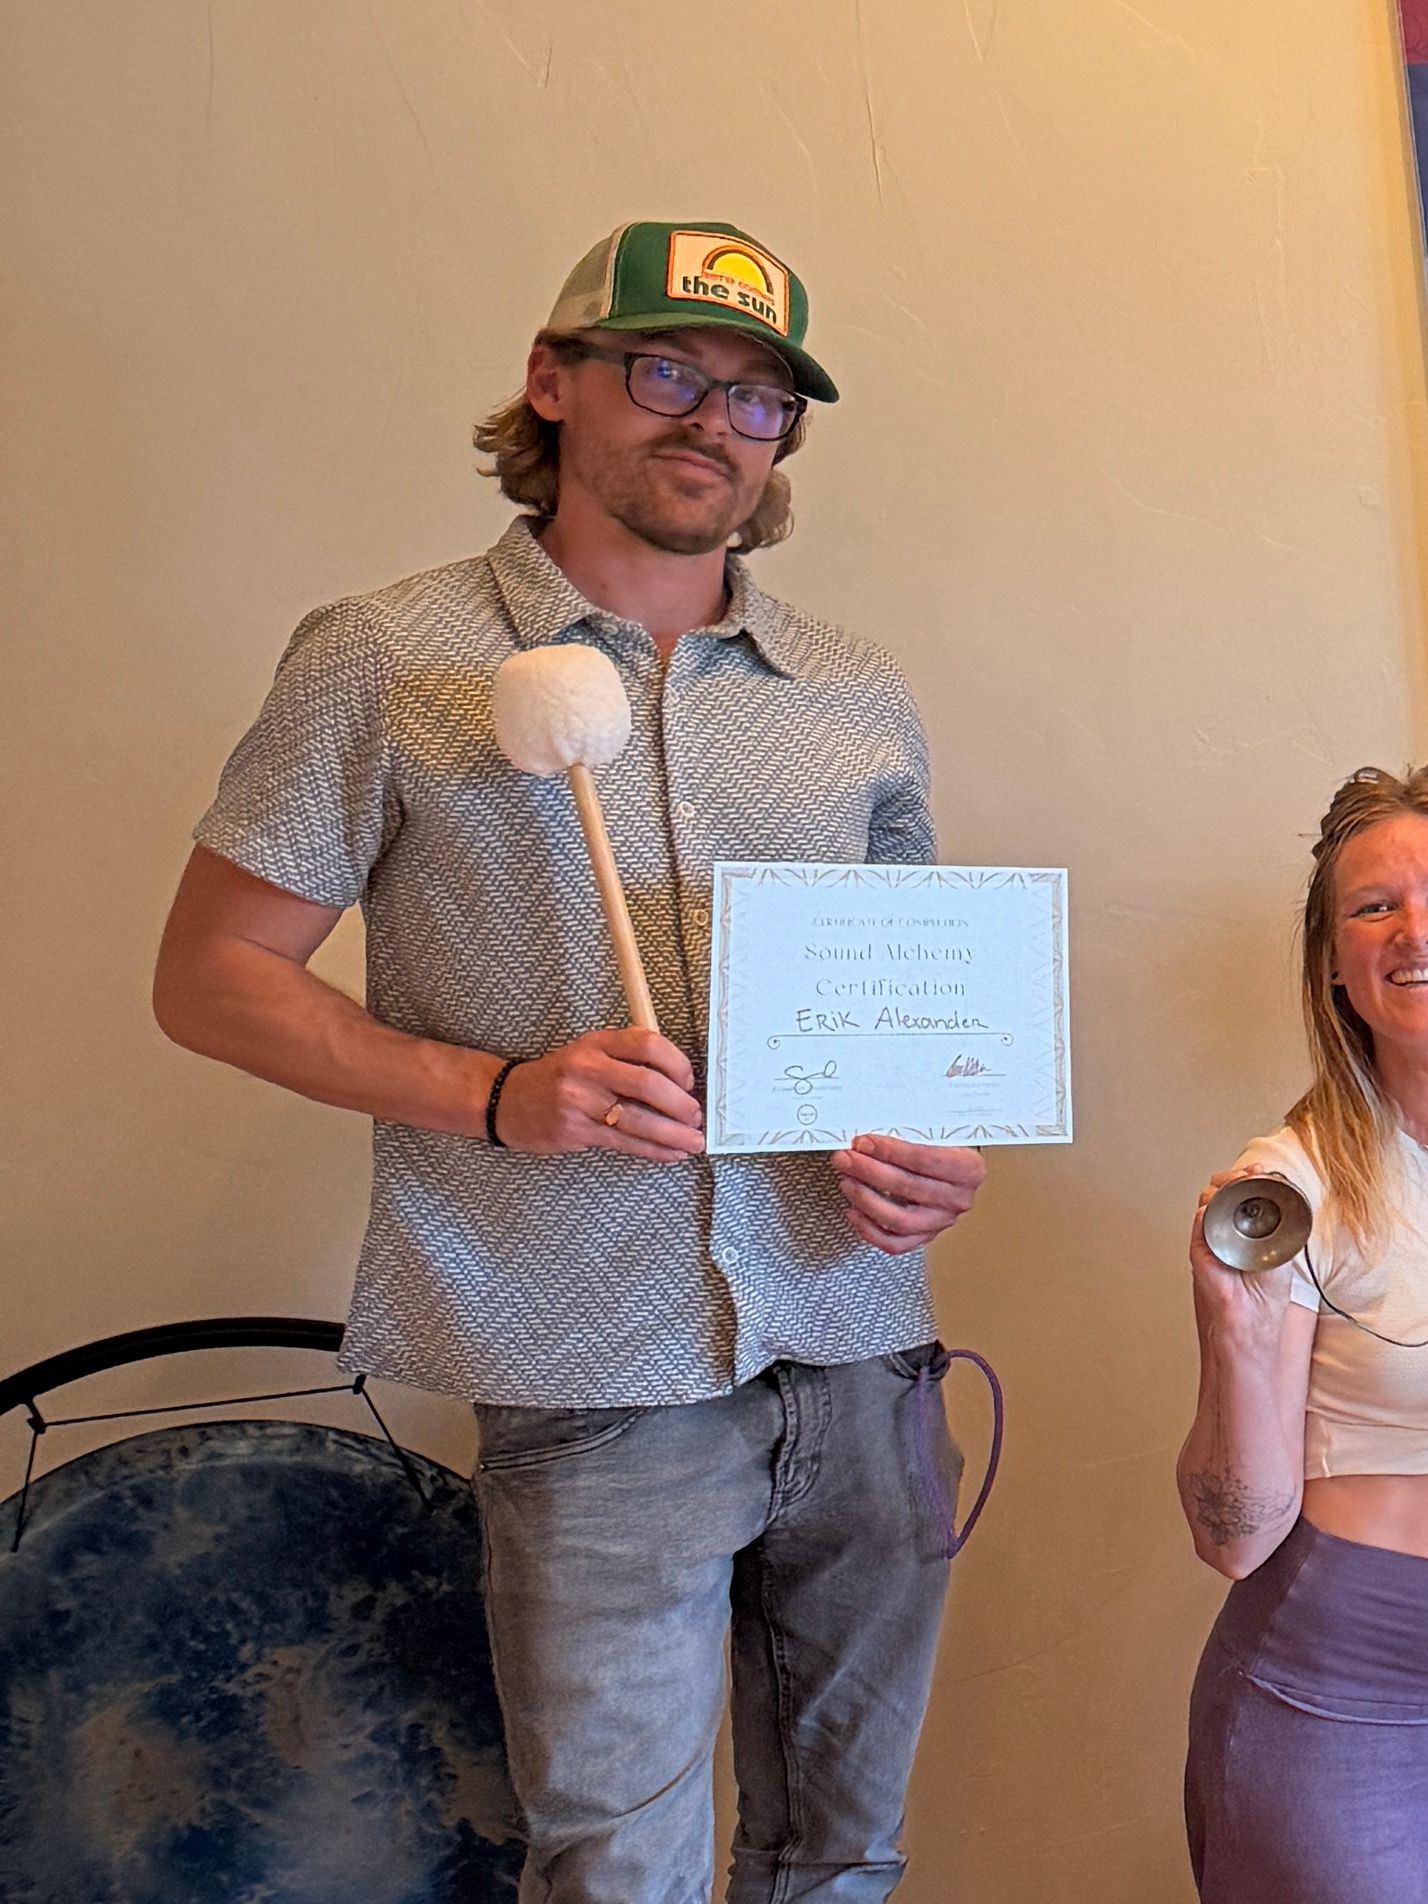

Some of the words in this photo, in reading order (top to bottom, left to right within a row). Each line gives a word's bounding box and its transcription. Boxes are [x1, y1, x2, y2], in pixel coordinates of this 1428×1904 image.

[682, 276, 730, 300] the
[737, 291, 777, 325] sun
[804, 943, 872, 961] Sound
[886, 943, 973, 965] Alchemy
[815, 978, 966, 996] Certification
